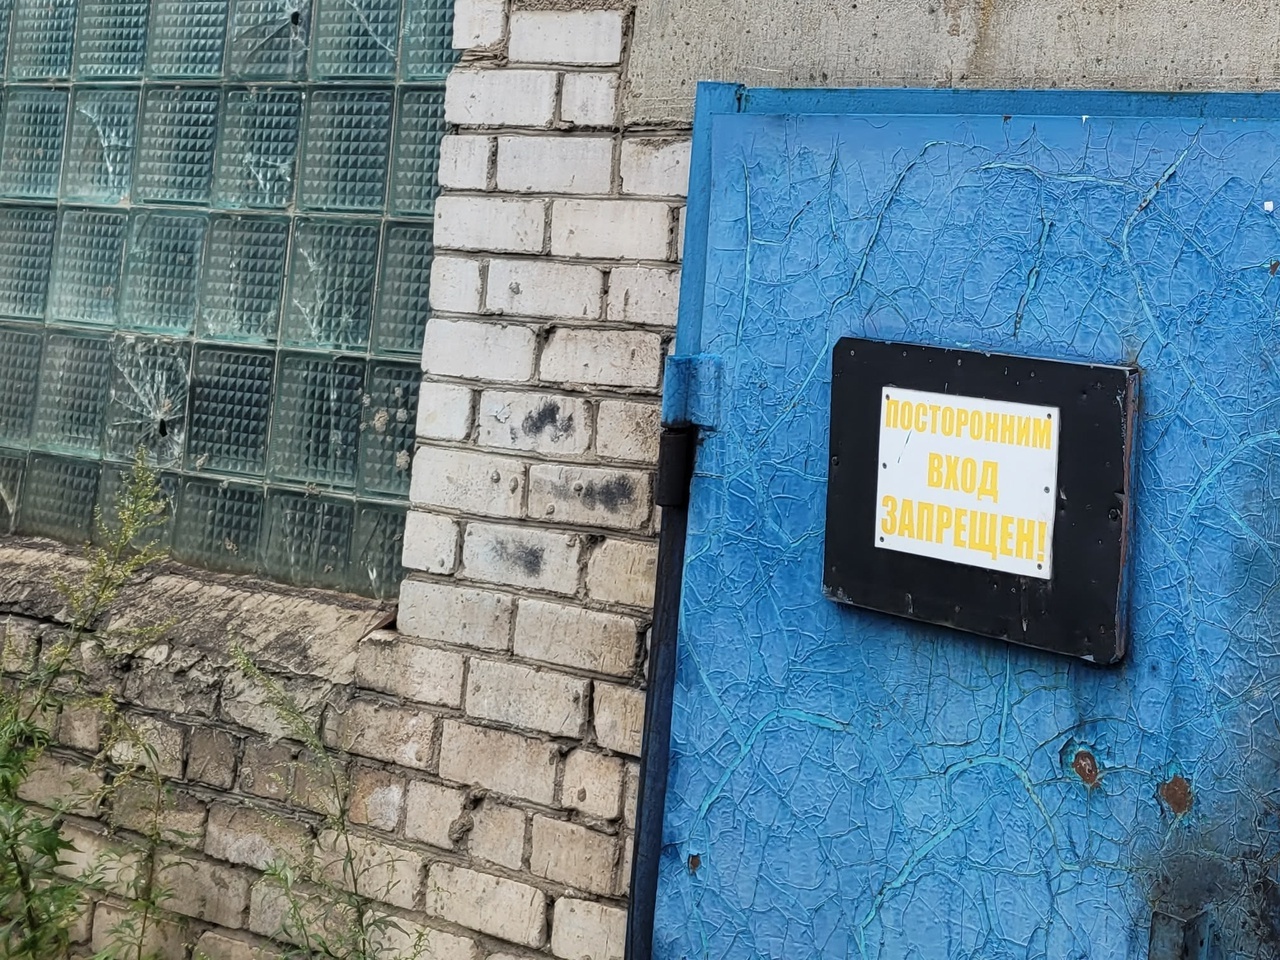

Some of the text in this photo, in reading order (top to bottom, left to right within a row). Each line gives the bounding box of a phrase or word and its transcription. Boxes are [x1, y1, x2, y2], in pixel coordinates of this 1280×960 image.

[885, 399, 1052, 450] ПОСТОРОННИМ
[927, 452, 999, 503] ВХОД
[880, 495, 1048, 562] ЗАПРЕЩЕН!
